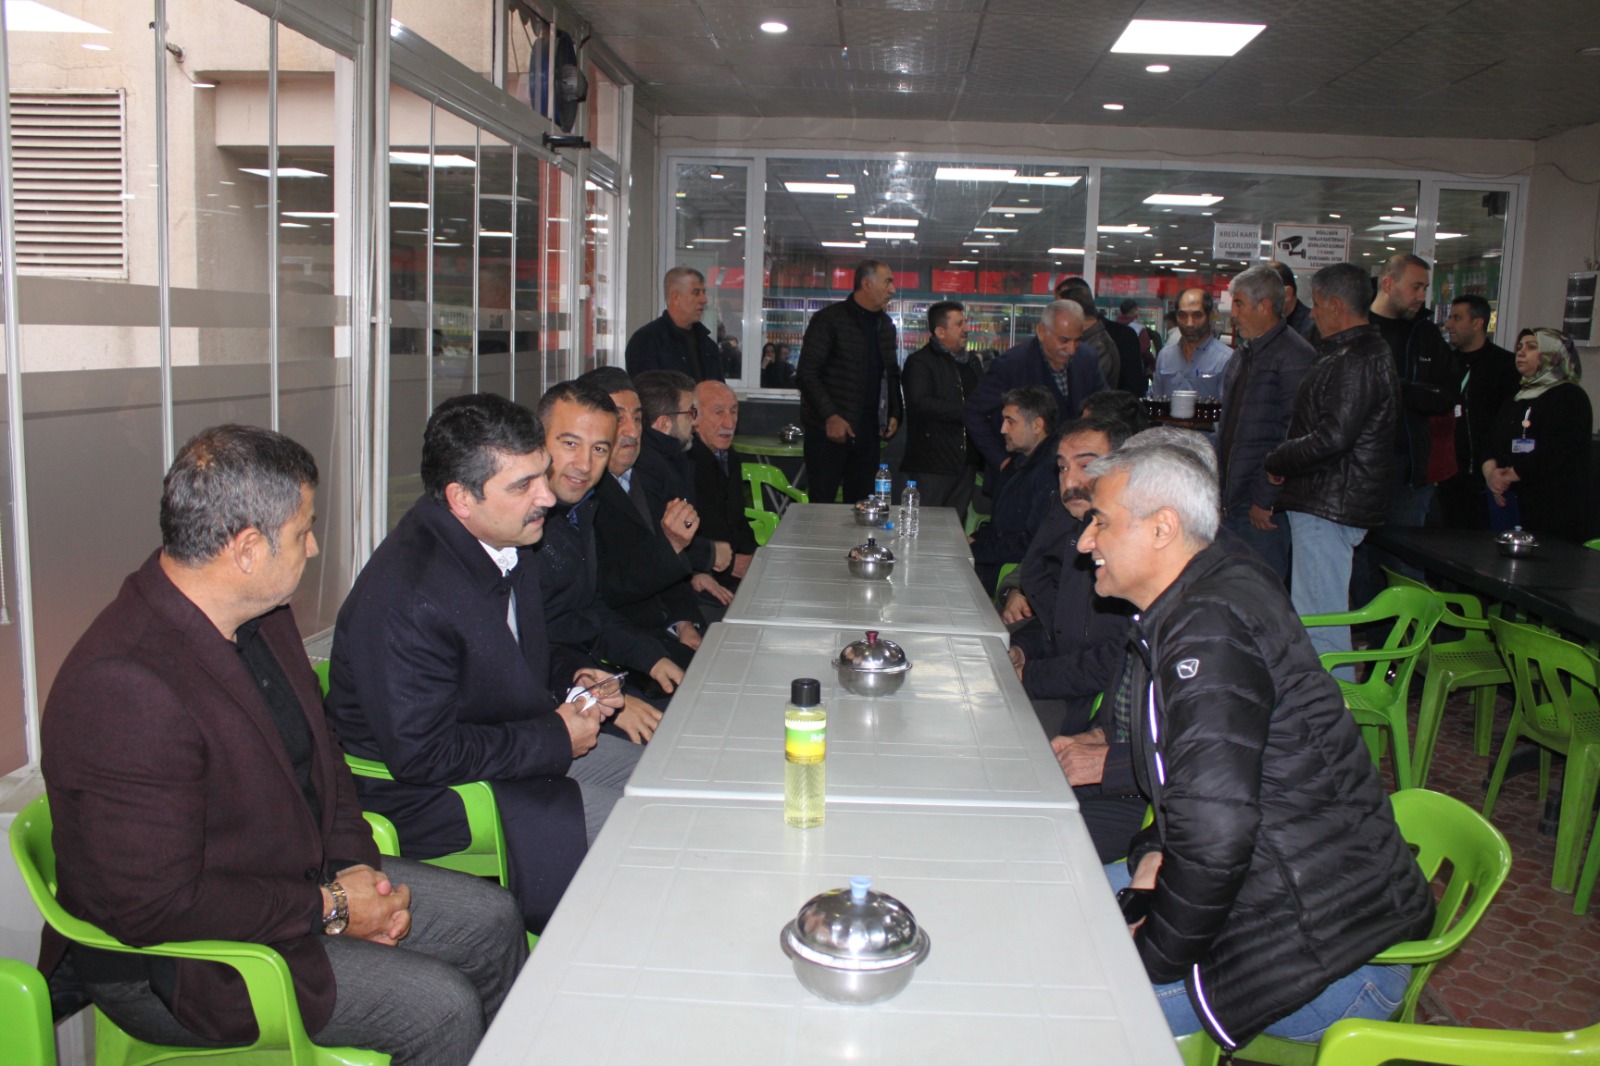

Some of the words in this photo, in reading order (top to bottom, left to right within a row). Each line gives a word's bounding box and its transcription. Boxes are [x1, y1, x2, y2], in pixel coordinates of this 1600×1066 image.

[1219, 230, 1239, 238] KREDİ
[1239, 231, 1259, 239] KARTI
[1218, 241, 1259, 250] GEÇERLİDİR
